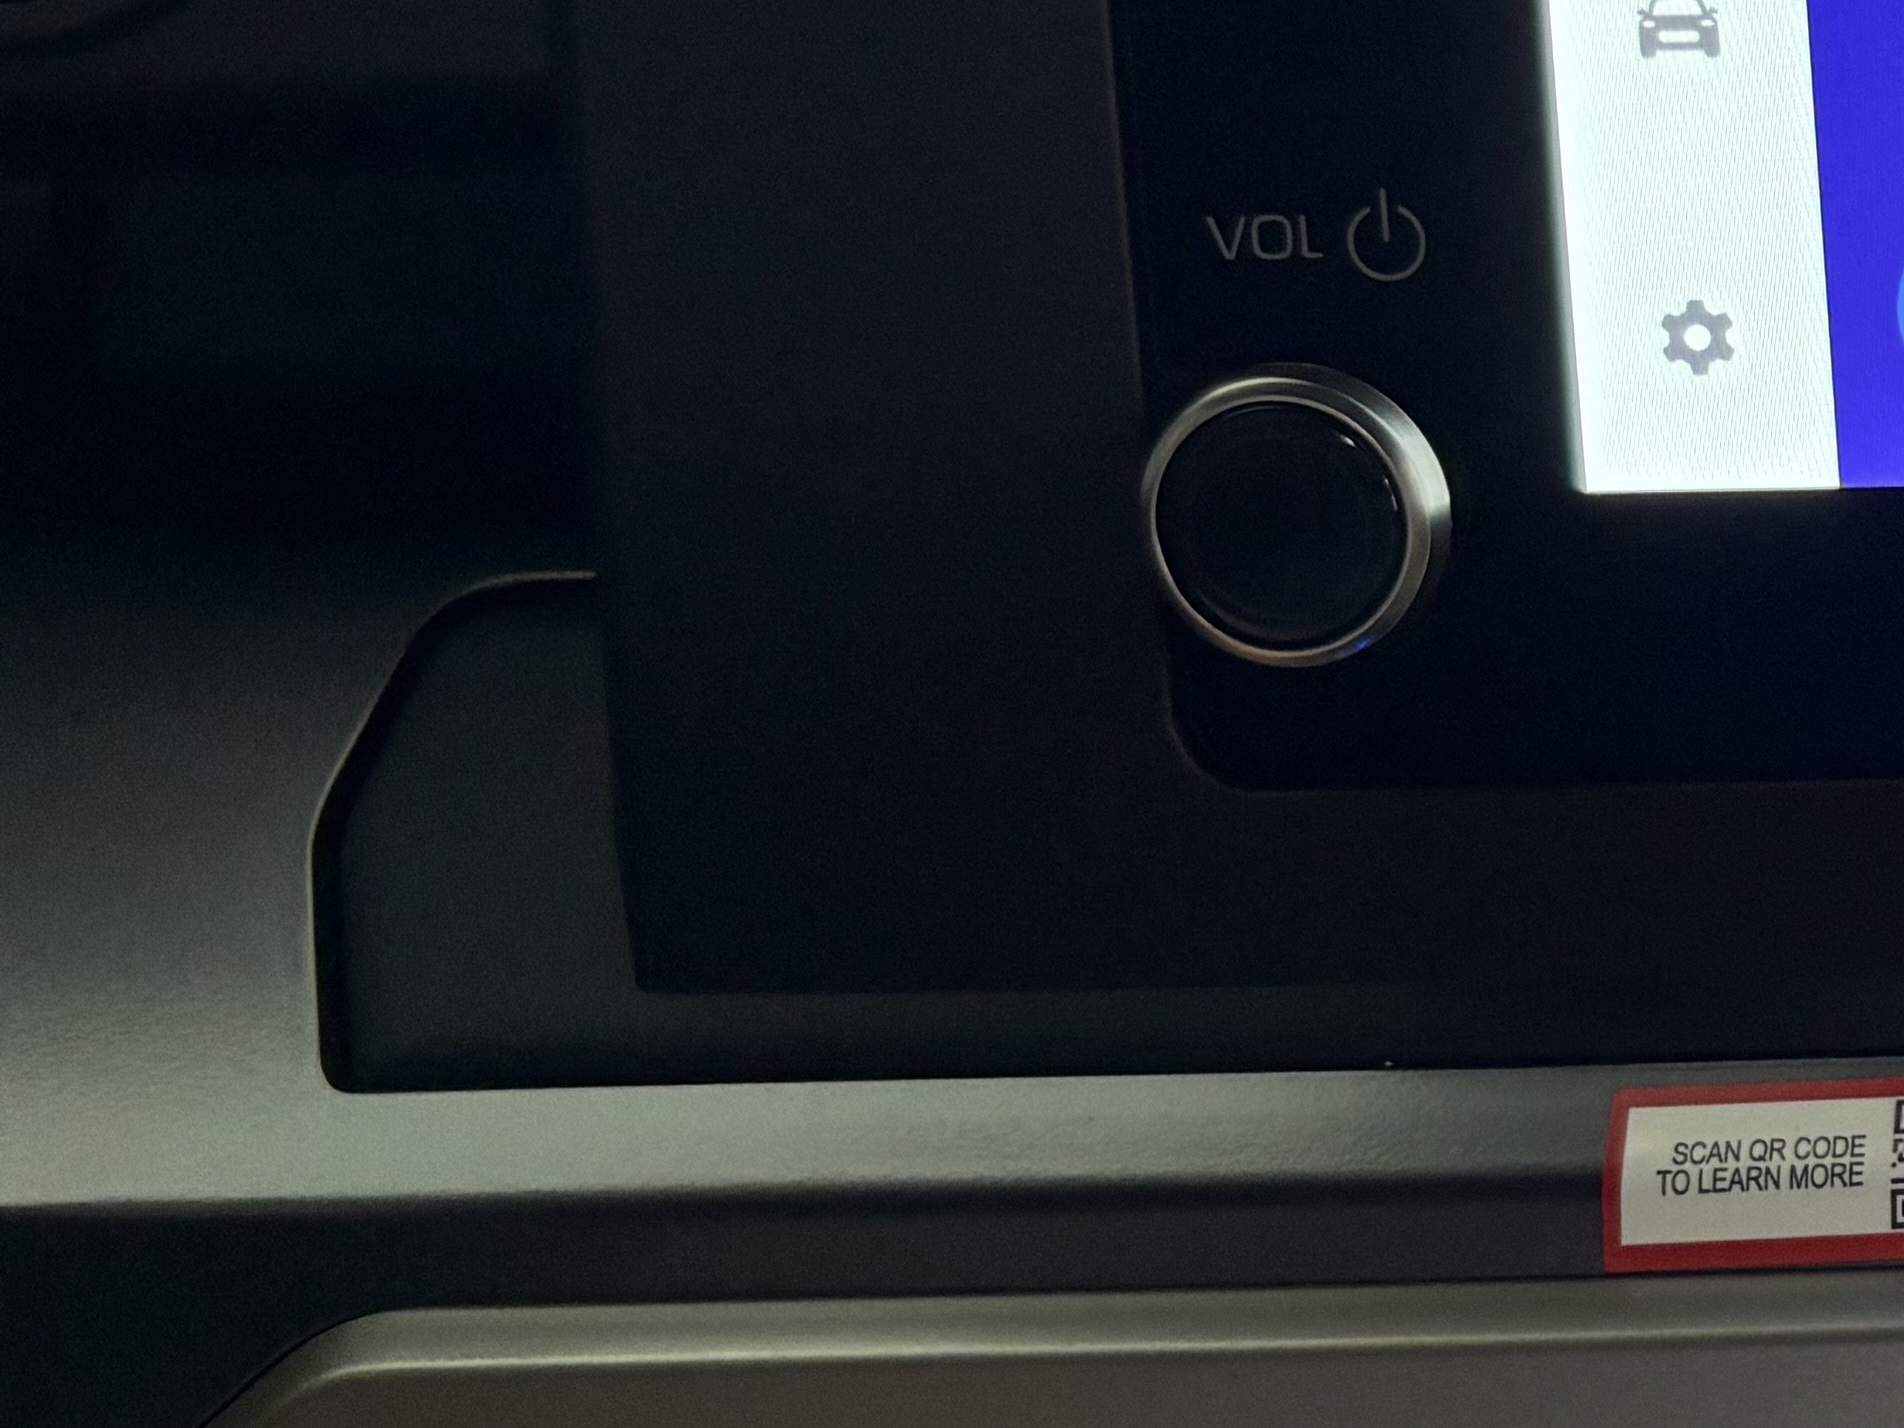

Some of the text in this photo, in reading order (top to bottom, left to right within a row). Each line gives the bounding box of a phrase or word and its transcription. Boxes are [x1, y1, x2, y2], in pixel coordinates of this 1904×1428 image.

[1206, 215, 1323, 260] VOL
[1672, 1135, 1866, 1165] SCAN QR CODE
[1656, 1162, 1864, 1196] TO LEARN MORE
